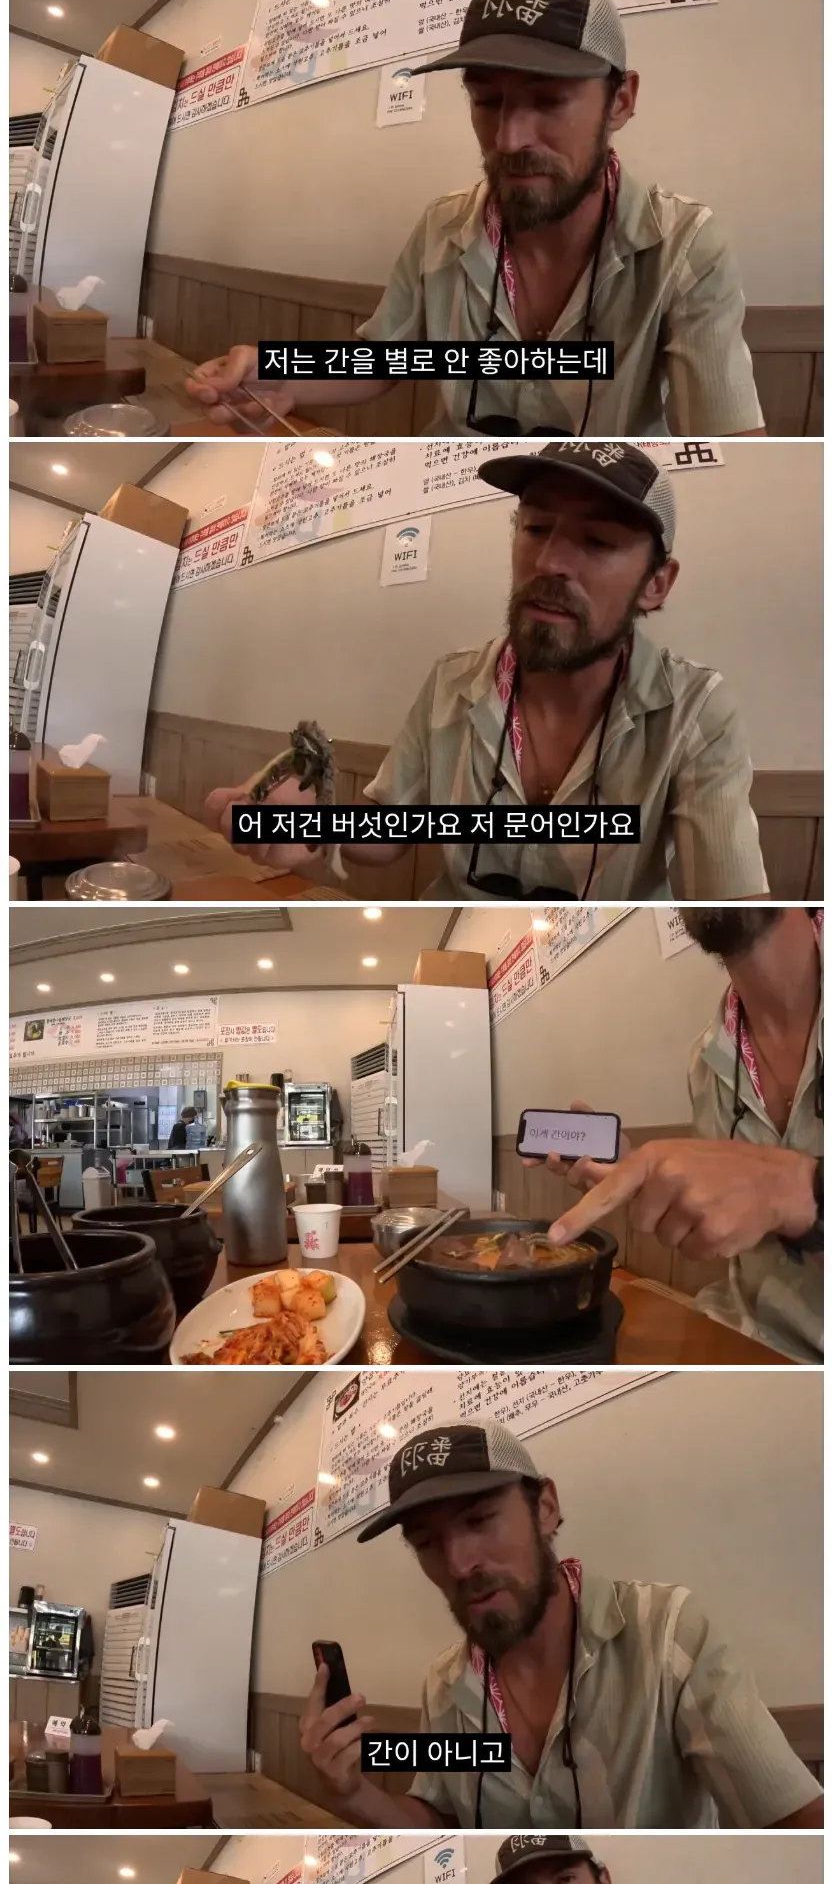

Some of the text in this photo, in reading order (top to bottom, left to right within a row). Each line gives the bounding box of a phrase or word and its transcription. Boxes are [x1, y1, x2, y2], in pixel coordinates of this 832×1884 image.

[390, 89, 413, 102] WIFI
[194, 532, 239, 565] 드실 만큼만
[394, 549, 417, 562] WIFI
[529, 1127, 587, 1141] 이게 간이야?
[434, 1868, 456, 1884] WIFI
